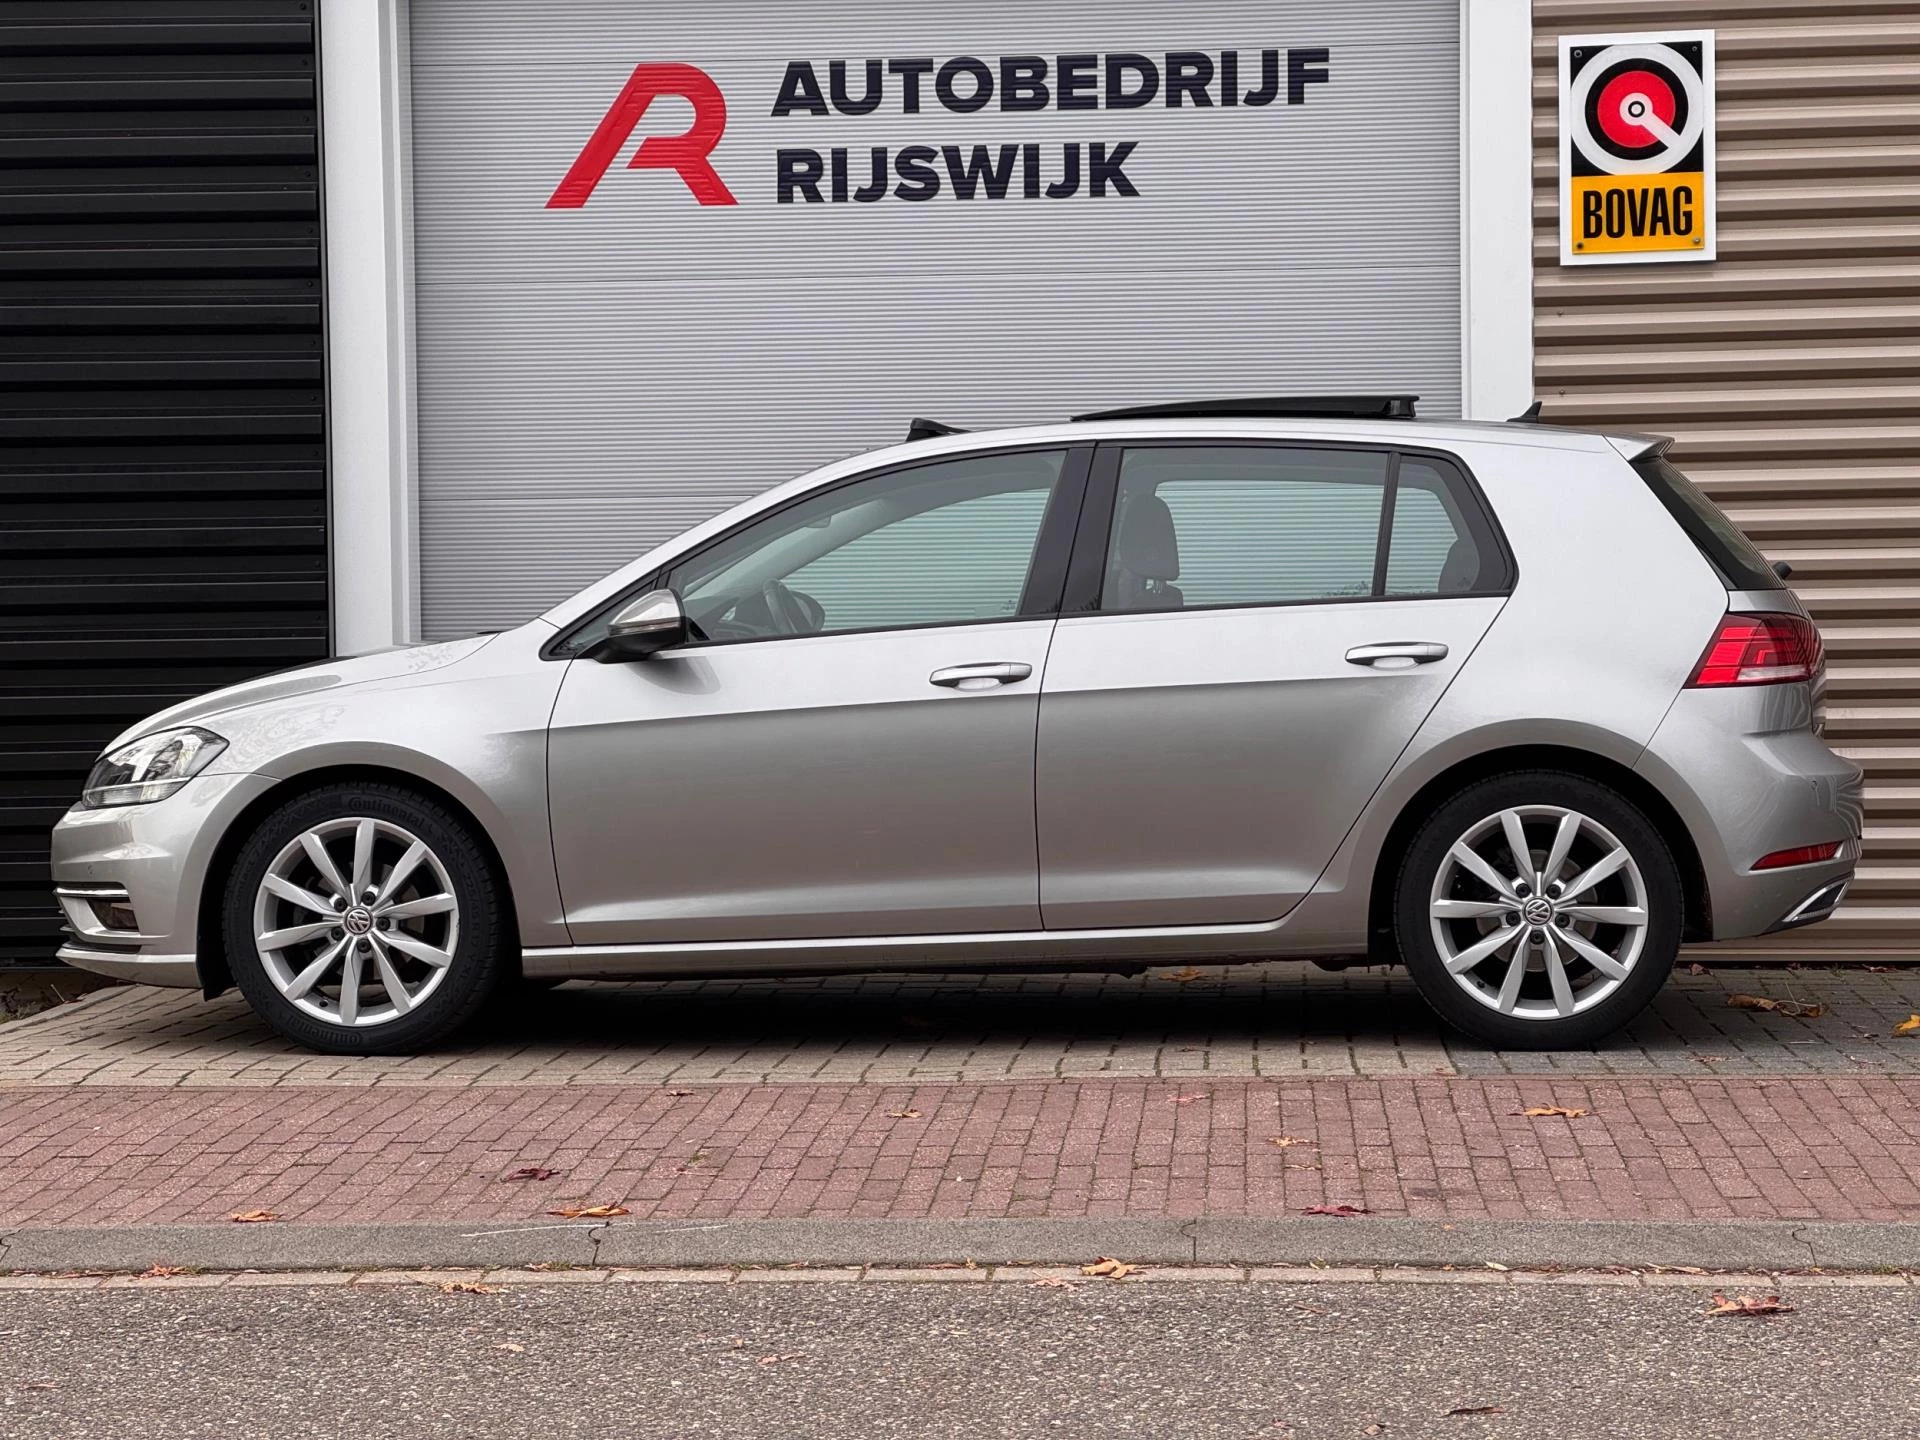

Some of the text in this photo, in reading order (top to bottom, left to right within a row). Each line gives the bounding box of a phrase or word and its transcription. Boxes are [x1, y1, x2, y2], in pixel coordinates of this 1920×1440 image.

[770, 47, 1331, 117] AUTOBEDRIJF
[775, 141, 1141, 204] RIJSWIJK
[1582, 185, 1694, 240] BOVAG
[347, 796, 426, 830] Continental
